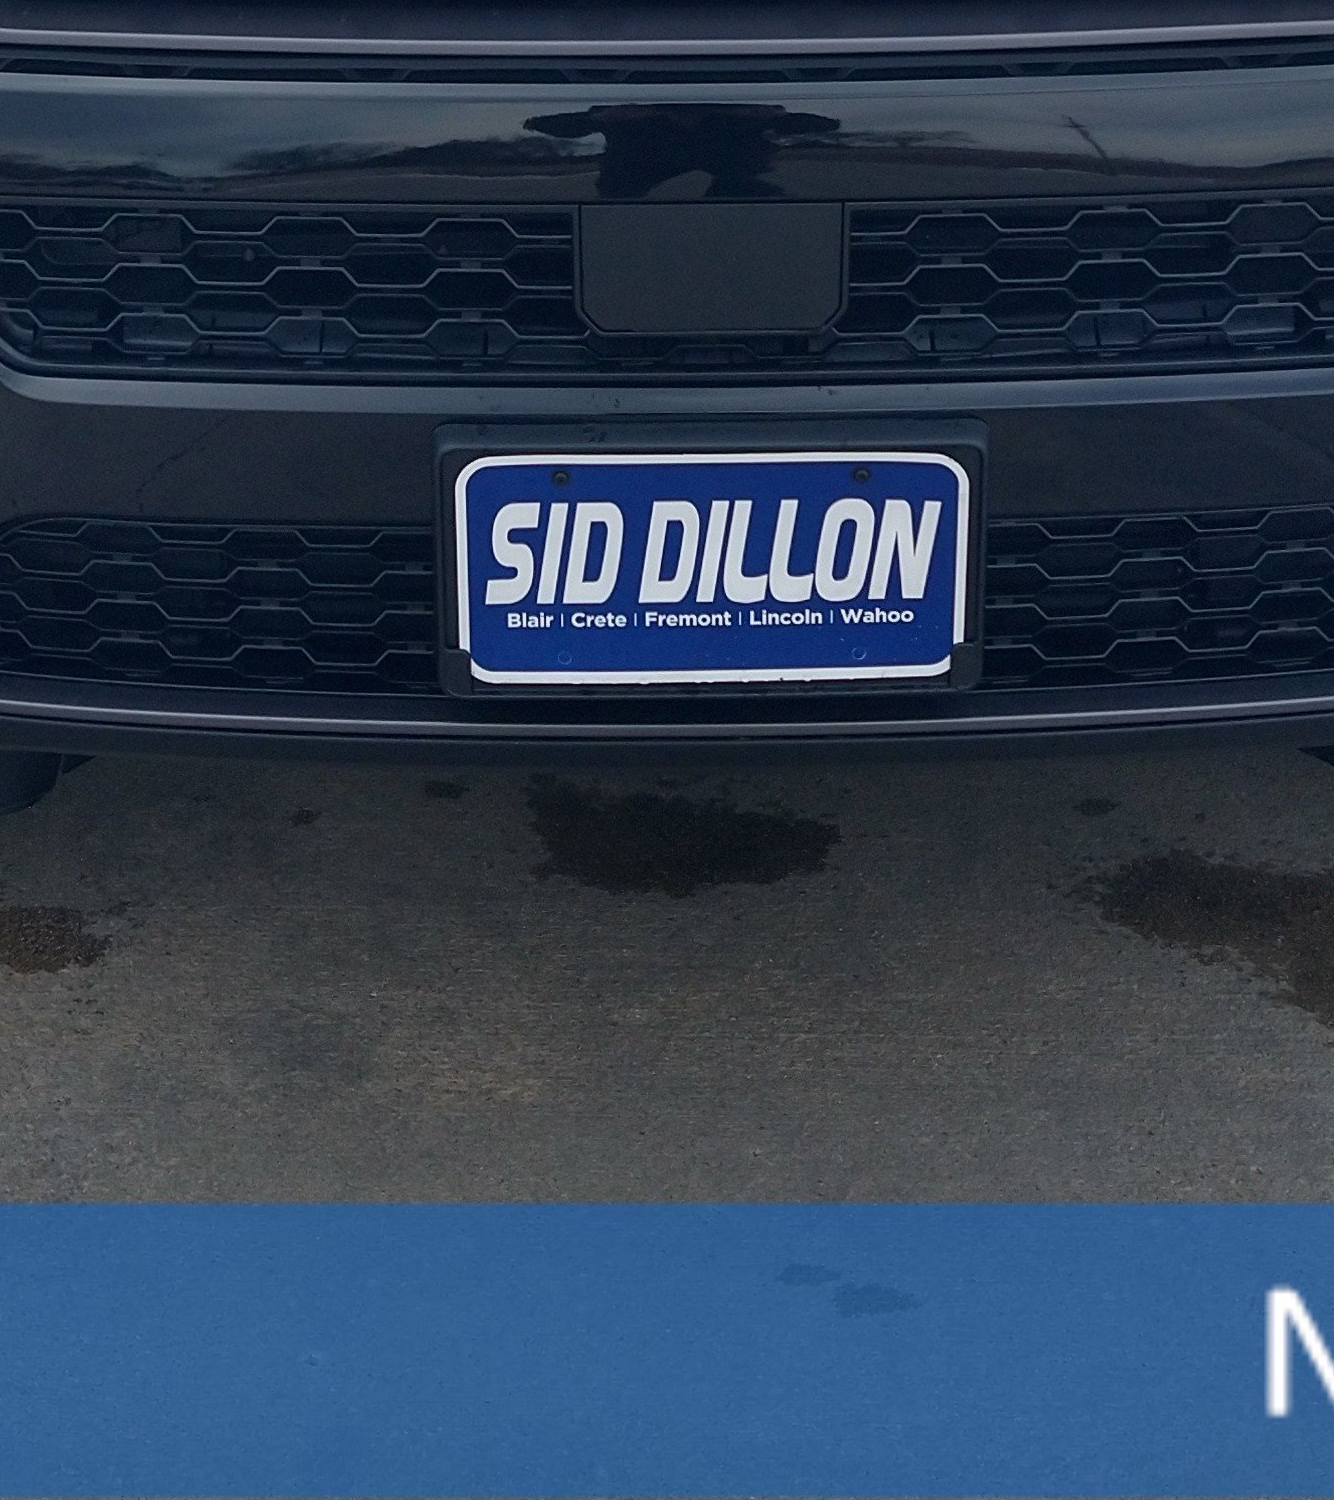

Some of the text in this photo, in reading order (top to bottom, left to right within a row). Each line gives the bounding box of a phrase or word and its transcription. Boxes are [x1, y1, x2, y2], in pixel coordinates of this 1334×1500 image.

[485, 498, 943, 605] SID DILLON
[507, 607, 915, 628] Blair Crete Fremont Lincoln Wahoo
